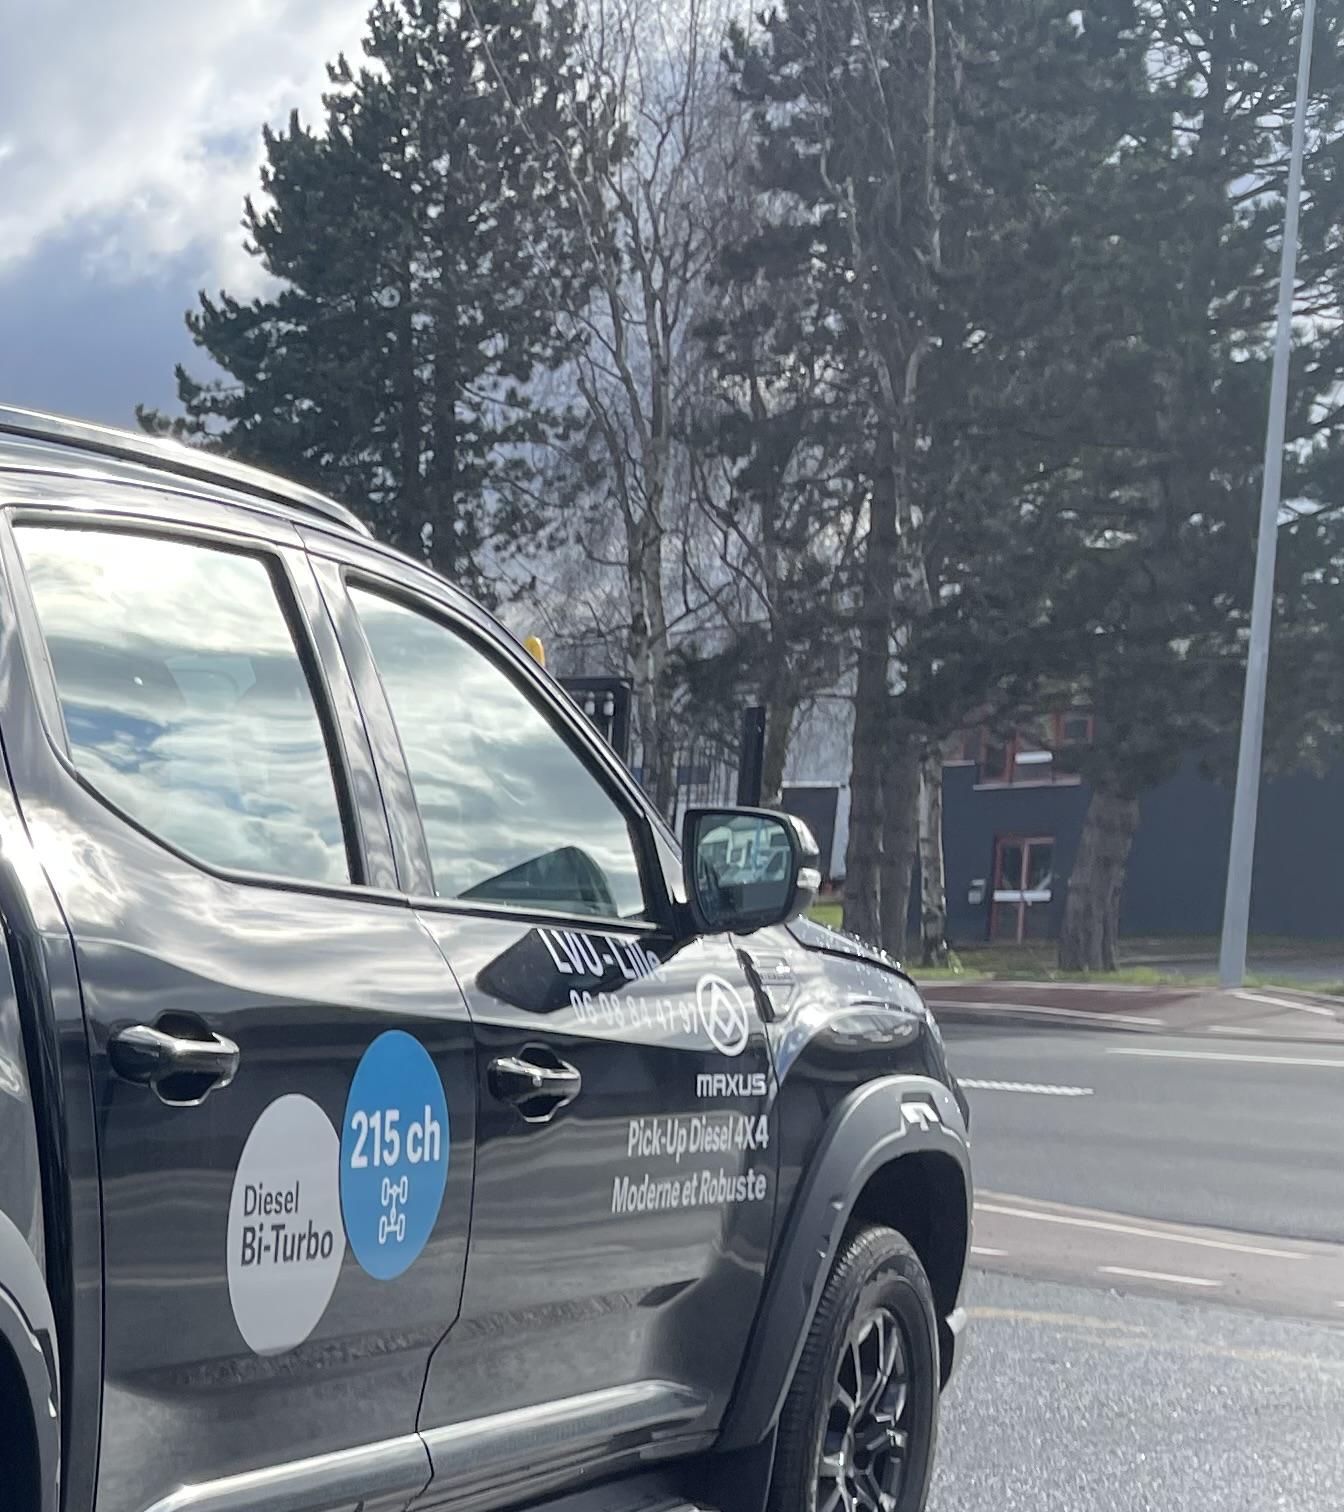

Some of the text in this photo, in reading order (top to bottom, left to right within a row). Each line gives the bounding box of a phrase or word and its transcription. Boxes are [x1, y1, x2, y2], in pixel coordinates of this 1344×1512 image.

[696, 1073, 767, 1098] MAXUS
[351, 1104, 441, 1169] 215 ch
[627, 1114, 769, 1164] Pick-Up Diesel 4X4
[243, 1180, 300, 1217] Diesel
[612, 1167, 767, 1213] Moderne et Robuste
[241, 1219, 334, 1267] Bi-Turbo
